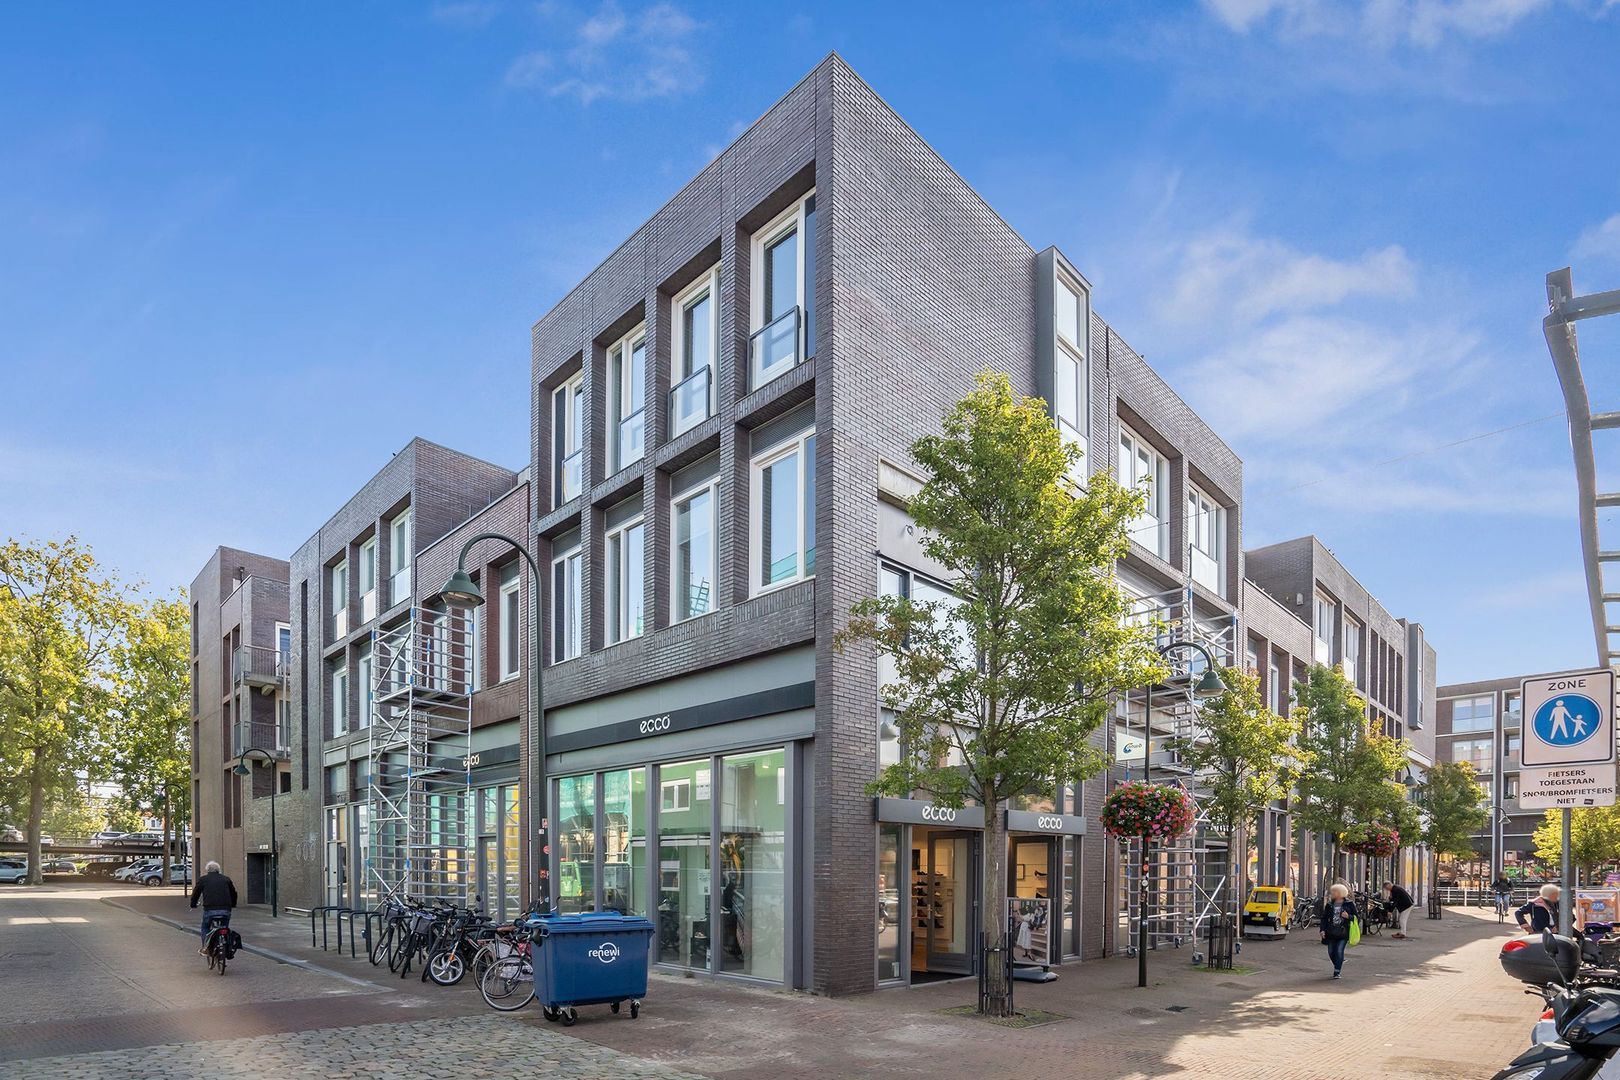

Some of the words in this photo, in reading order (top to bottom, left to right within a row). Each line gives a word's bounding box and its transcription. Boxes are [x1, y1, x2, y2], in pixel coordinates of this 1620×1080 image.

[1548, 679, 1586, 691] ZONE
[639, 714, 670, 734] ecco
[1548, 769, 1586, 778] FIETSERS
[1539, 778, 1595, 787] TOEGESTAAN
[1522, 787, 1613, 798] SNOR/BROMFIETSERS
[1556, 797, 1576, 805] NIET
[922, 805, 956, 822] ecco
[1038, 816, 1062, 830] ecco
[588, 946, 620, 958] renewi
